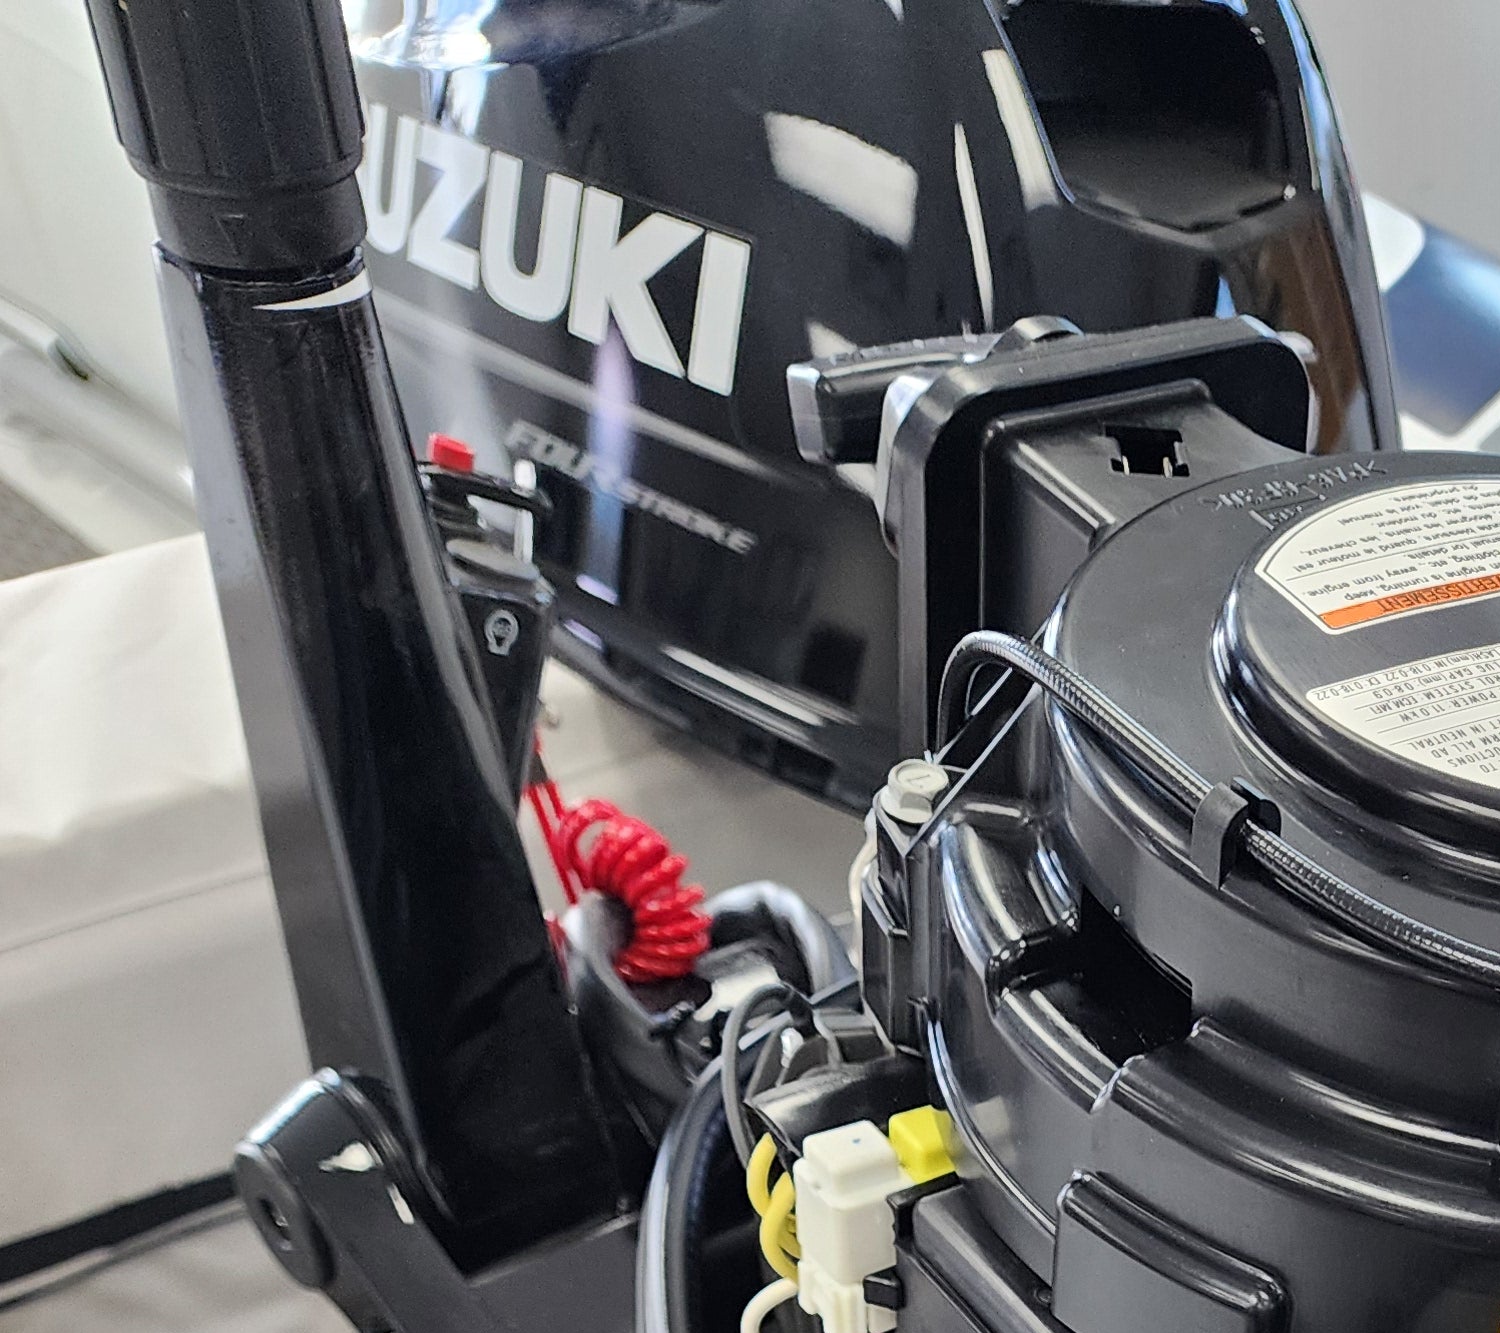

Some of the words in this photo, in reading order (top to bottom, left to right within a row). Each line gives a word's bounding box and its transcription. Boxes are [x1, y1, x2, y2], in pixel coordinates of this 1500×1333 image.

[355, 102, 752, 396] UZUKI
[1377, 537, 1418, 551] quand
[1316, 551, 1361, 565] moteur
[1402, 546, 1449, 561] details.
[1384, 564, 1418, 577] away
[1443, 563, 1487, 579] engine
[1352, 573, 1384, 586] from
[1375, 576, 1430, 593] running,
[1300, 580, 1351, 599] engine.
[1342, 587, 1376, 601] keep
[1417, 680, 1473, 701] SYSTEM:
[1445, 690, 1496, 709] POWER:
[1398, 710, 1418, 722] kW
[1469, 723, 1486, 734] IN
[1407, 728, 1468, 751] NEUTRAL
[1450, 739, 1475, 753] ALL
[1430, 746, 1449, 758] AD
[1478, 761, 1496, 773] TO
